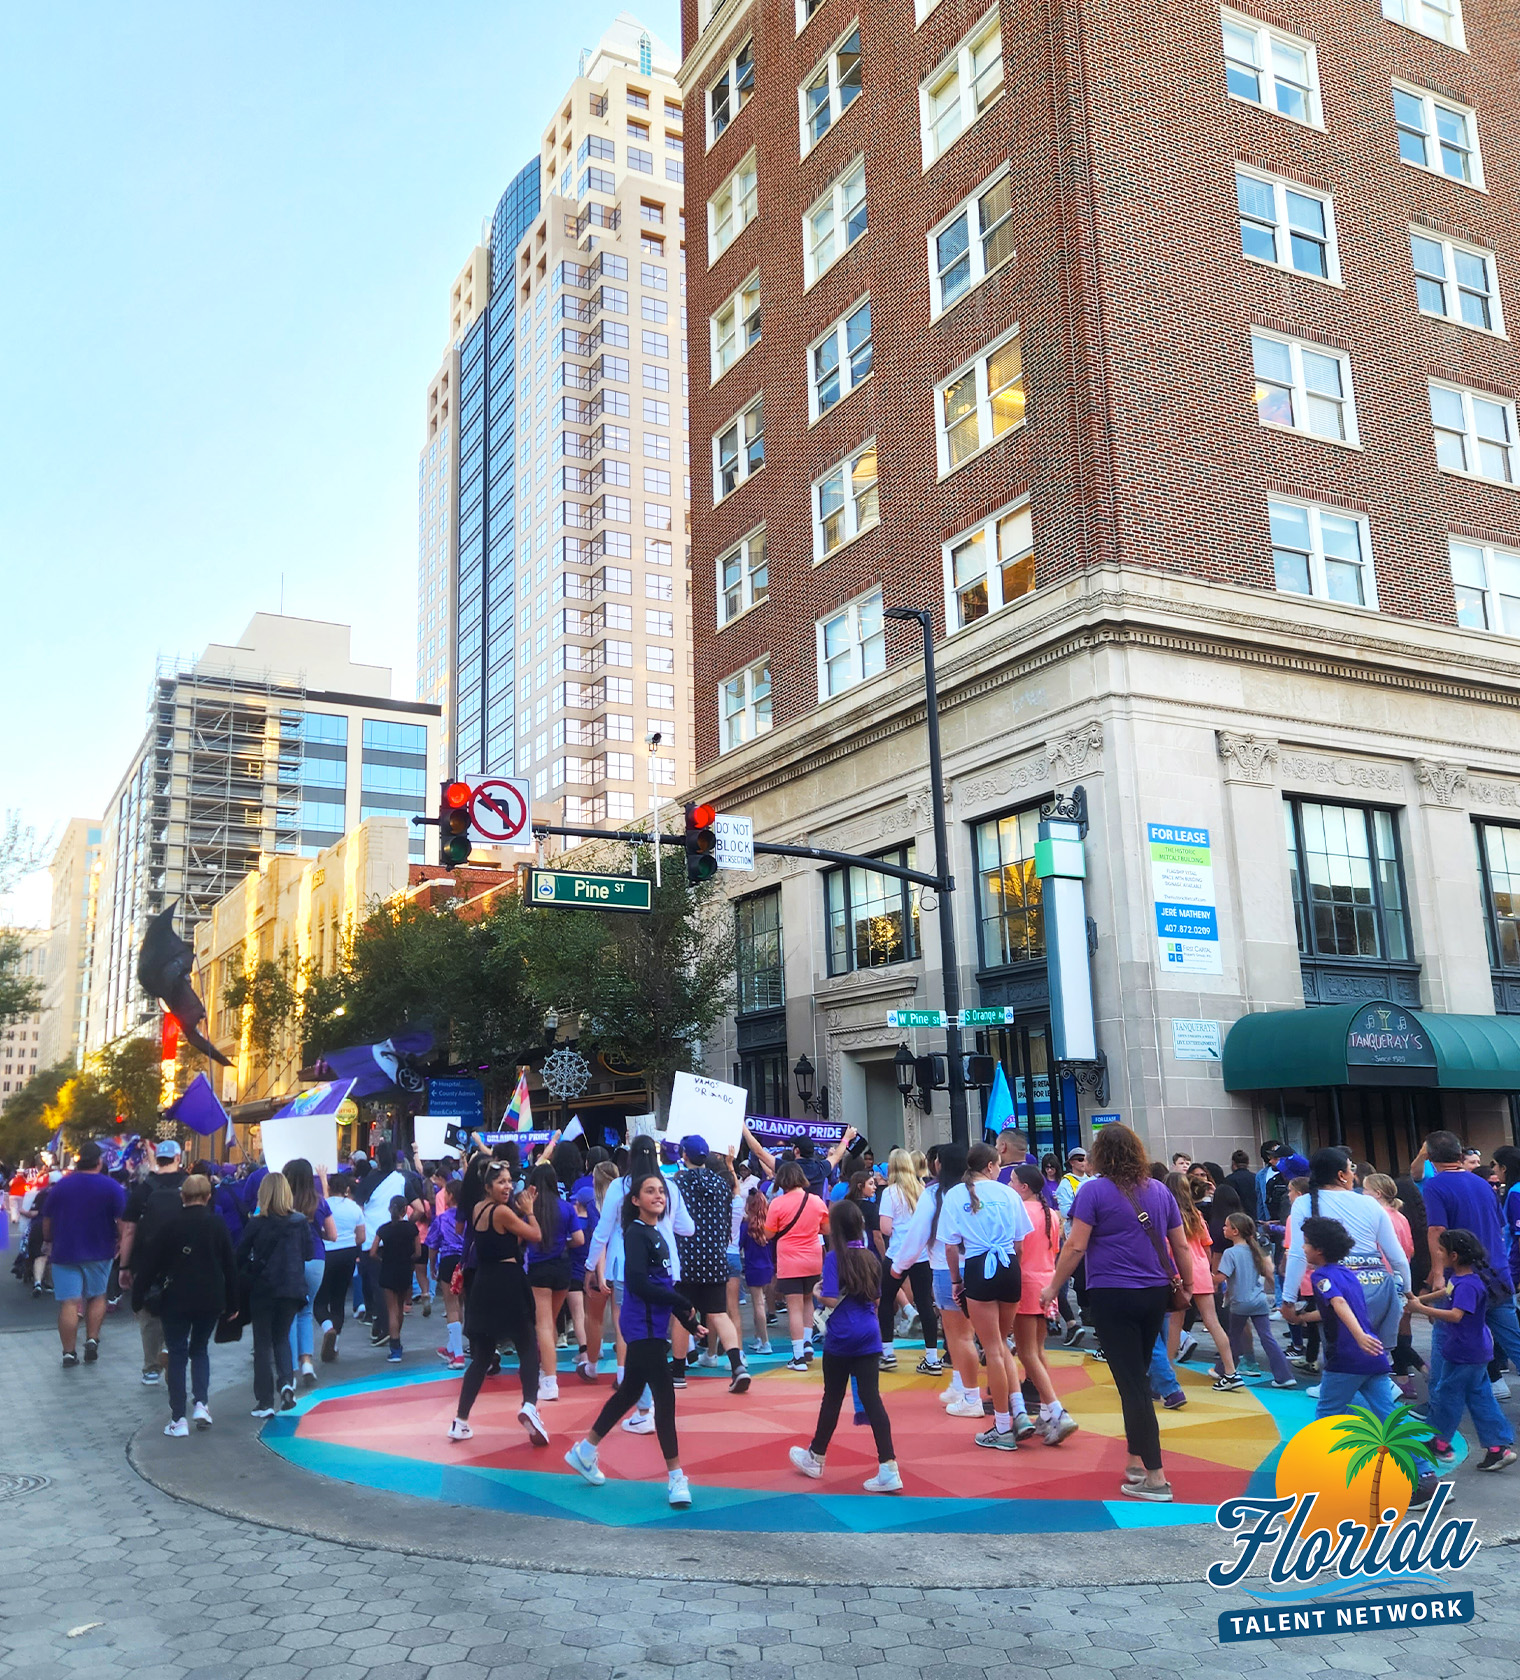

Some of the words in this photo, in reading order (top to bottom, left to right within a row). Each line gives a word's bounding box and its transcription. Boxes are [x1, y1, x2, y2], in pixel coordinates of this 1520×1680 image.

[716, 821, 729, 834] DO
[733, 823, 750, 836] NOT
[1151, 827, 1173, 841] FOR
[1174, 830, 1207, 844] LEASE
[716, 838, 751, 853] BLOCK
[716, 854, 752, 865] INTERSECTION
[574, 879, 610, 900] Pine
[614, 882, 626, 893] ST
[1161, 906, 1177, 917] JERÉ
[1178, 908, 1211, 919] MATHENY
[1164, 924, 1211, 935] 407.872.0209
[898, 1012, 907, 1024] W
[910, 1012, 929, 1024] Pine
[965, 1010, 971, 1020] S
[972, 1009, 996, 1024] Orange
[1175, 1022, 1216, 1032] TANQUERAY'S
[1350, 1031, 1423, 1051] TANQUERAY'S
[694, 1077, 720, 1089] VAMOS
[1033, 1090, 1045, 1098] FOR
[745, 1118, 806, 1137] ORLANDO
[808, 1125, 842, 1139] PRIDE
[486, 1134, 519, 1143] ORLANDO
[528, 1133, 550, 1141] PRIDE
